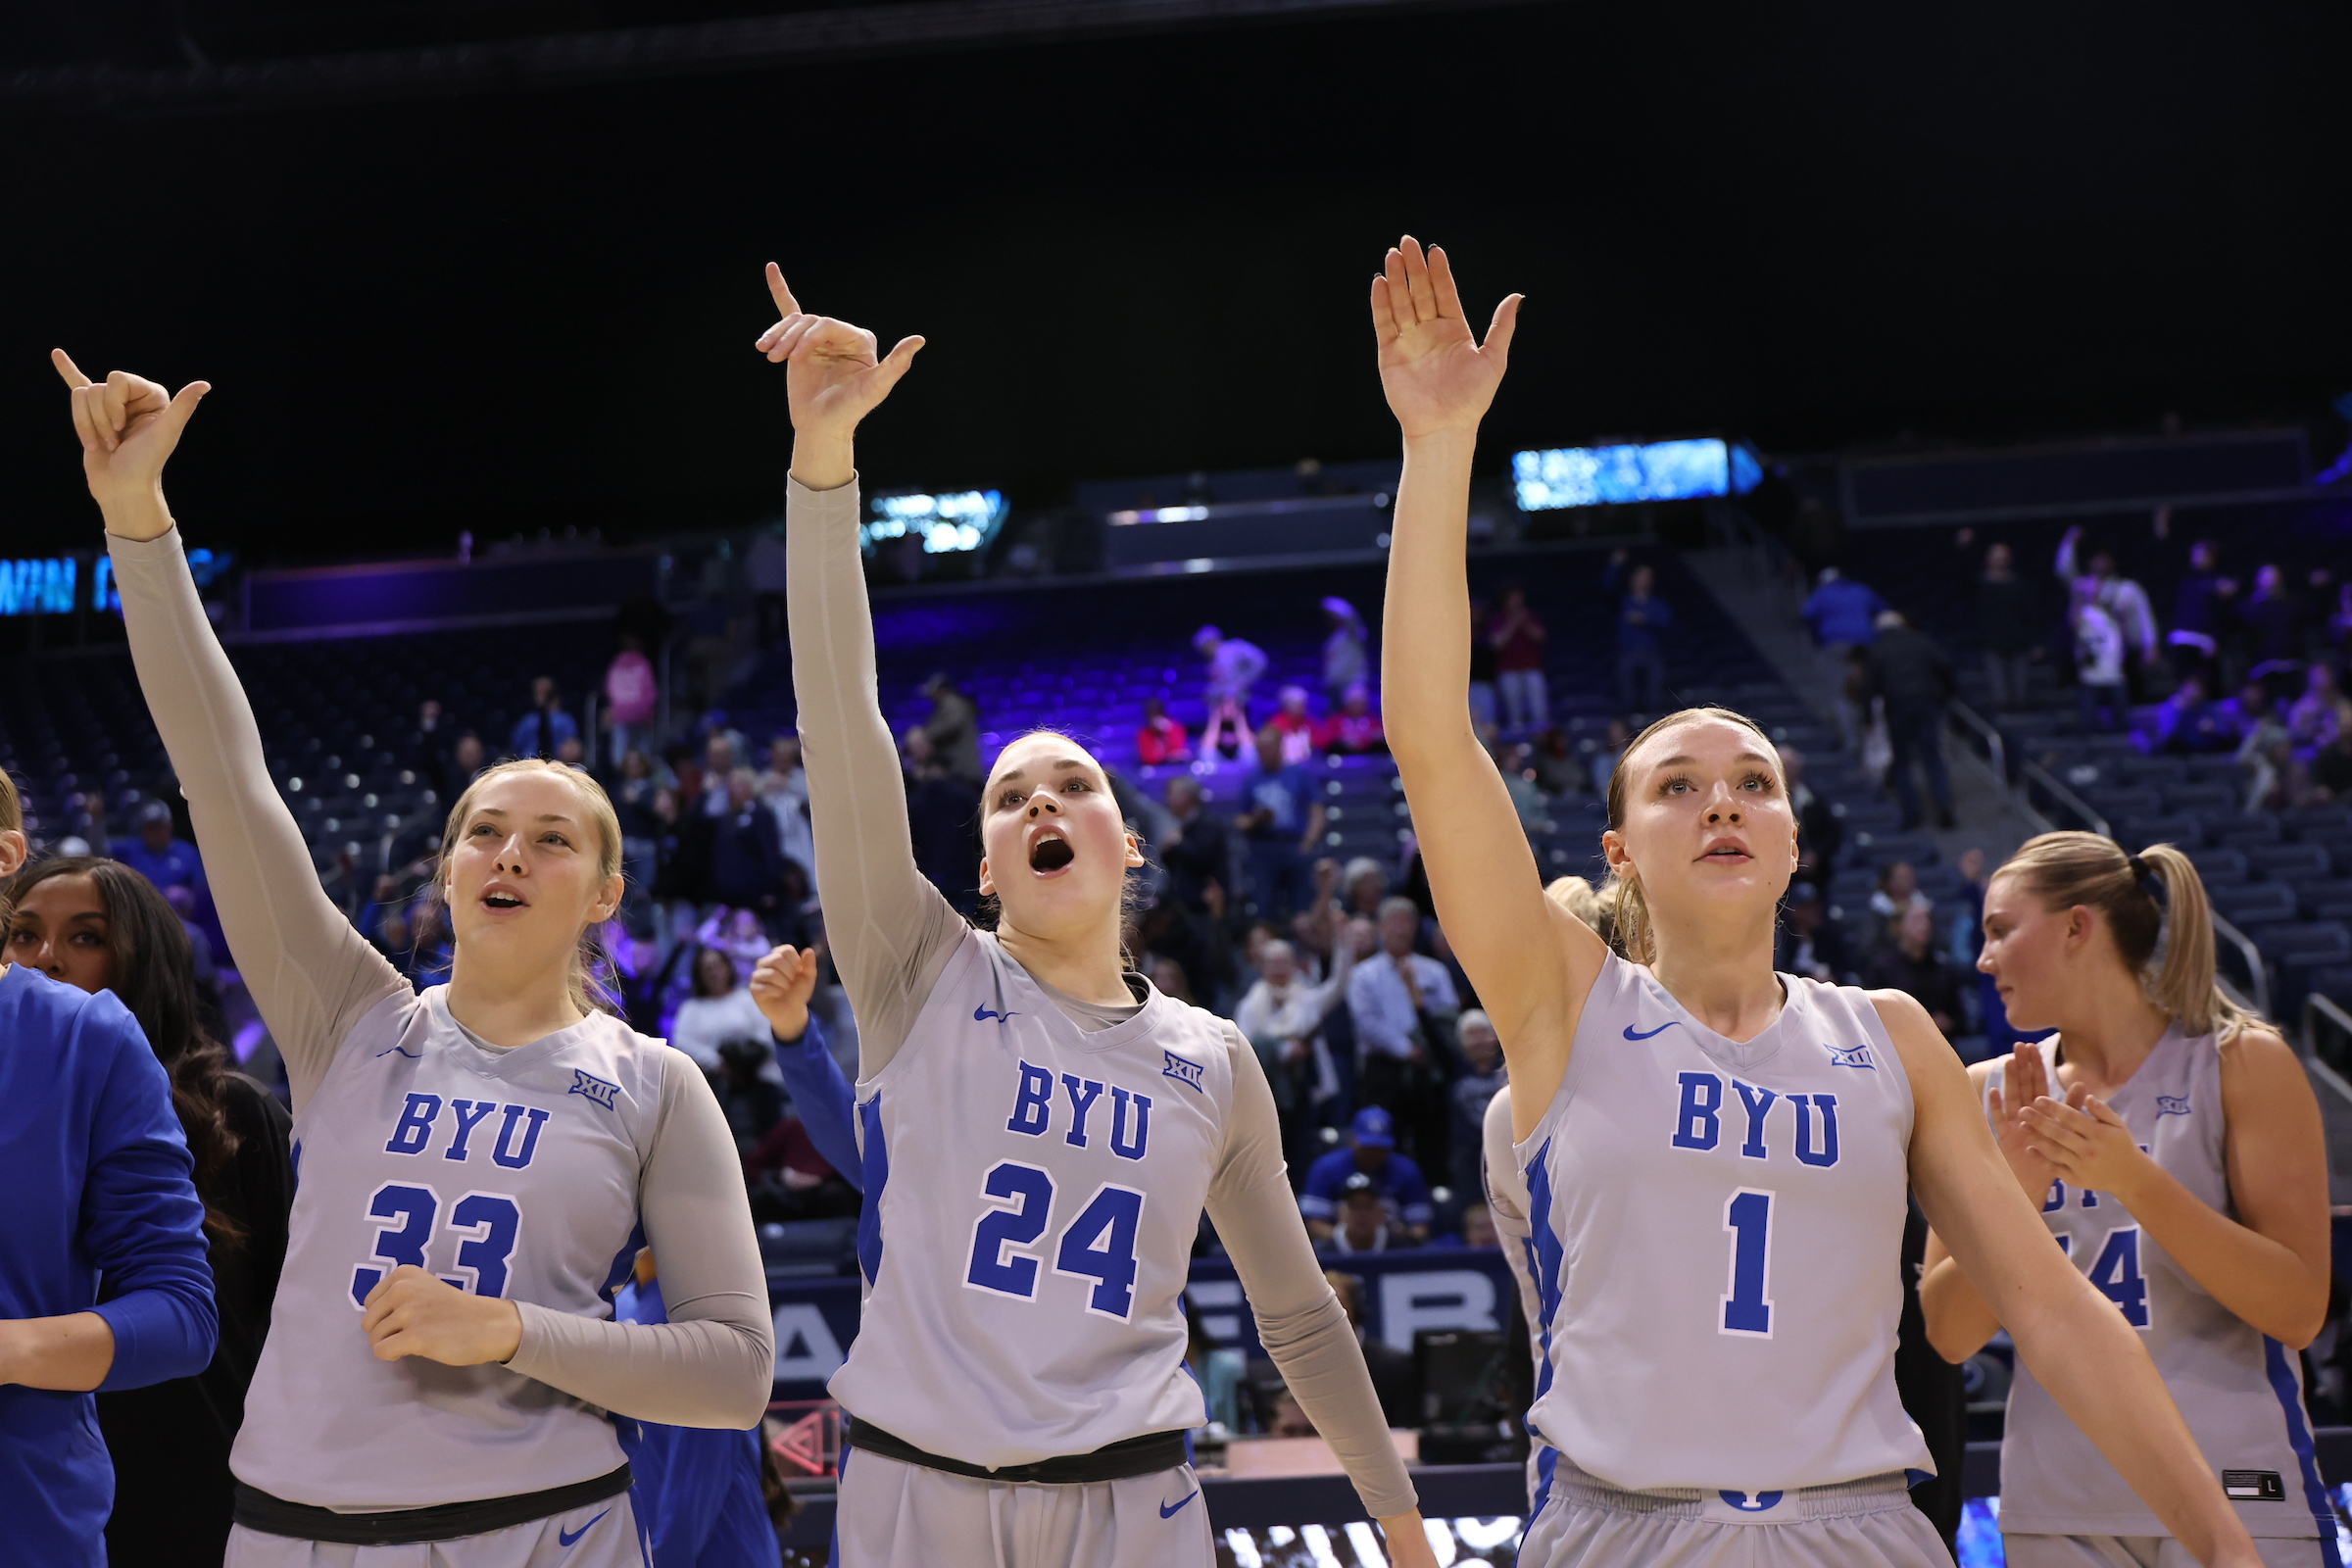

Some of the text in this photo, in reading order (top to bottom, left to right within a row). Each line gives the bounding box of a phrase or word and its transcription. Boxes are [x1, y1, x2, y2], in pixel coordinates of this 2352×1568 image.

[568, 1068, 621, 1111] XII
[1004, 1057, 1153, 1163] BYU
[1162, 1050, 1203, 1094] XII
[1670, 1070, 1840, 1170] BYU
[383, 1092, 552, 1171] BYU
[348, 1180, 523, 1312] 33
[962, 1157, 1148, 1324] 24
[1718, 1186, 1776, 1340] 1
[2267, 1479, 2277, 1493] L
